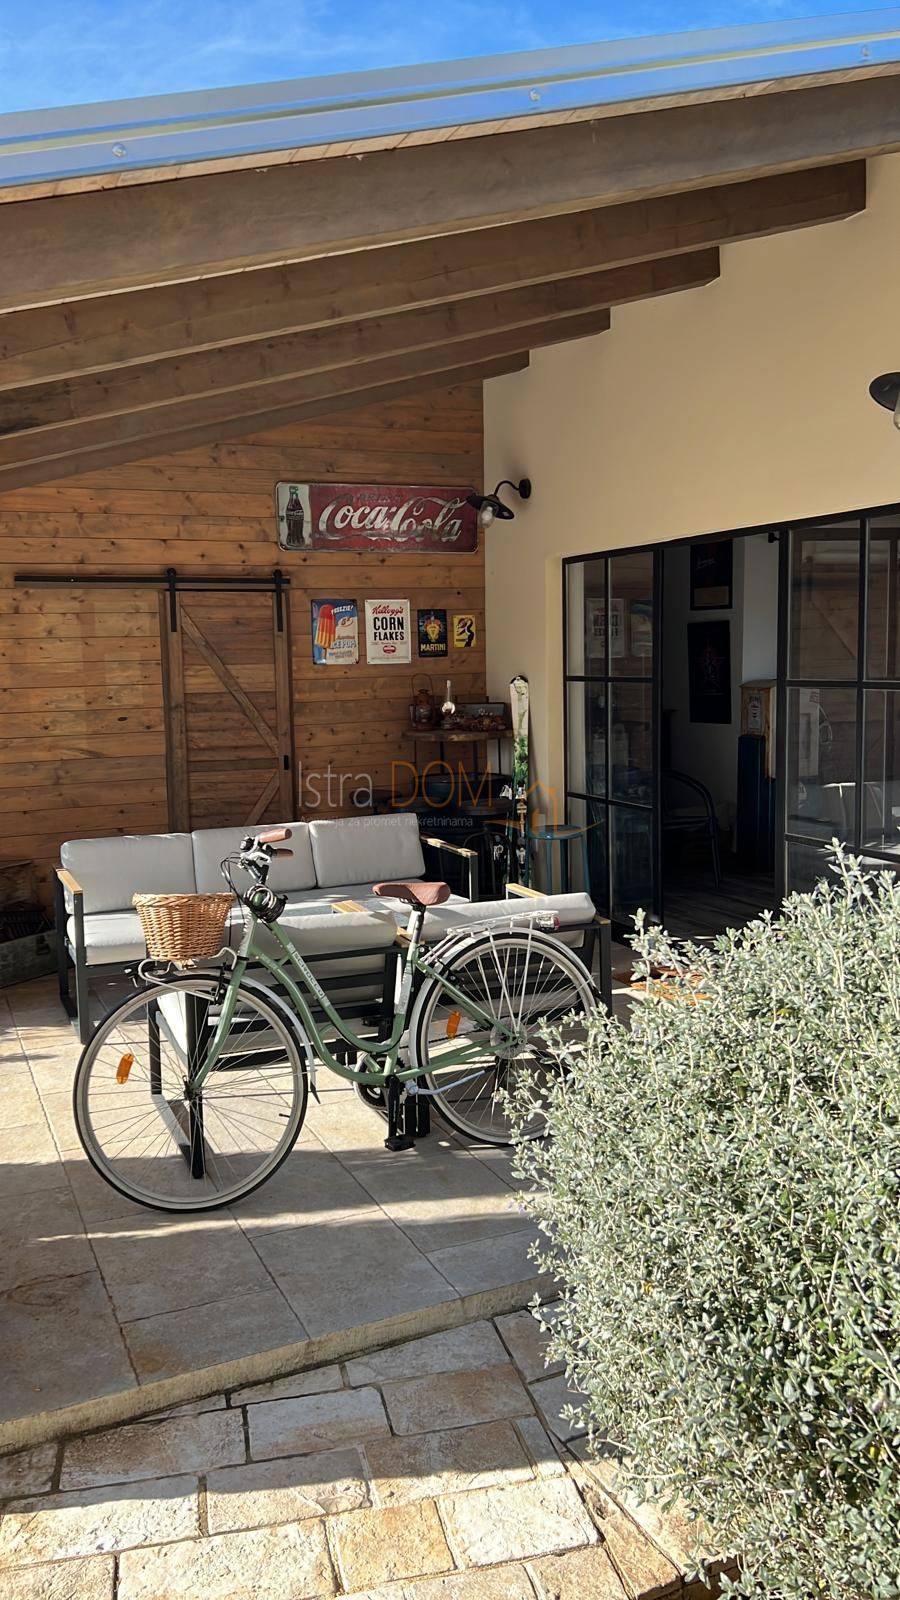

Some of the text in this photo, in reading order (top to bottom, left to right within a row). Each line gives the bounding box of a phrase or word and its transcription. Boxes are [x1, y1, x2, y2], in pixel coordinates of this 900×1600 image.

[372, 604, 404, 616] Kellogg's
[373, 616, 404, 631] CORN
[373, 631, 405, 641] FLAKES
[420, 643, 446, 652] MARTINI
